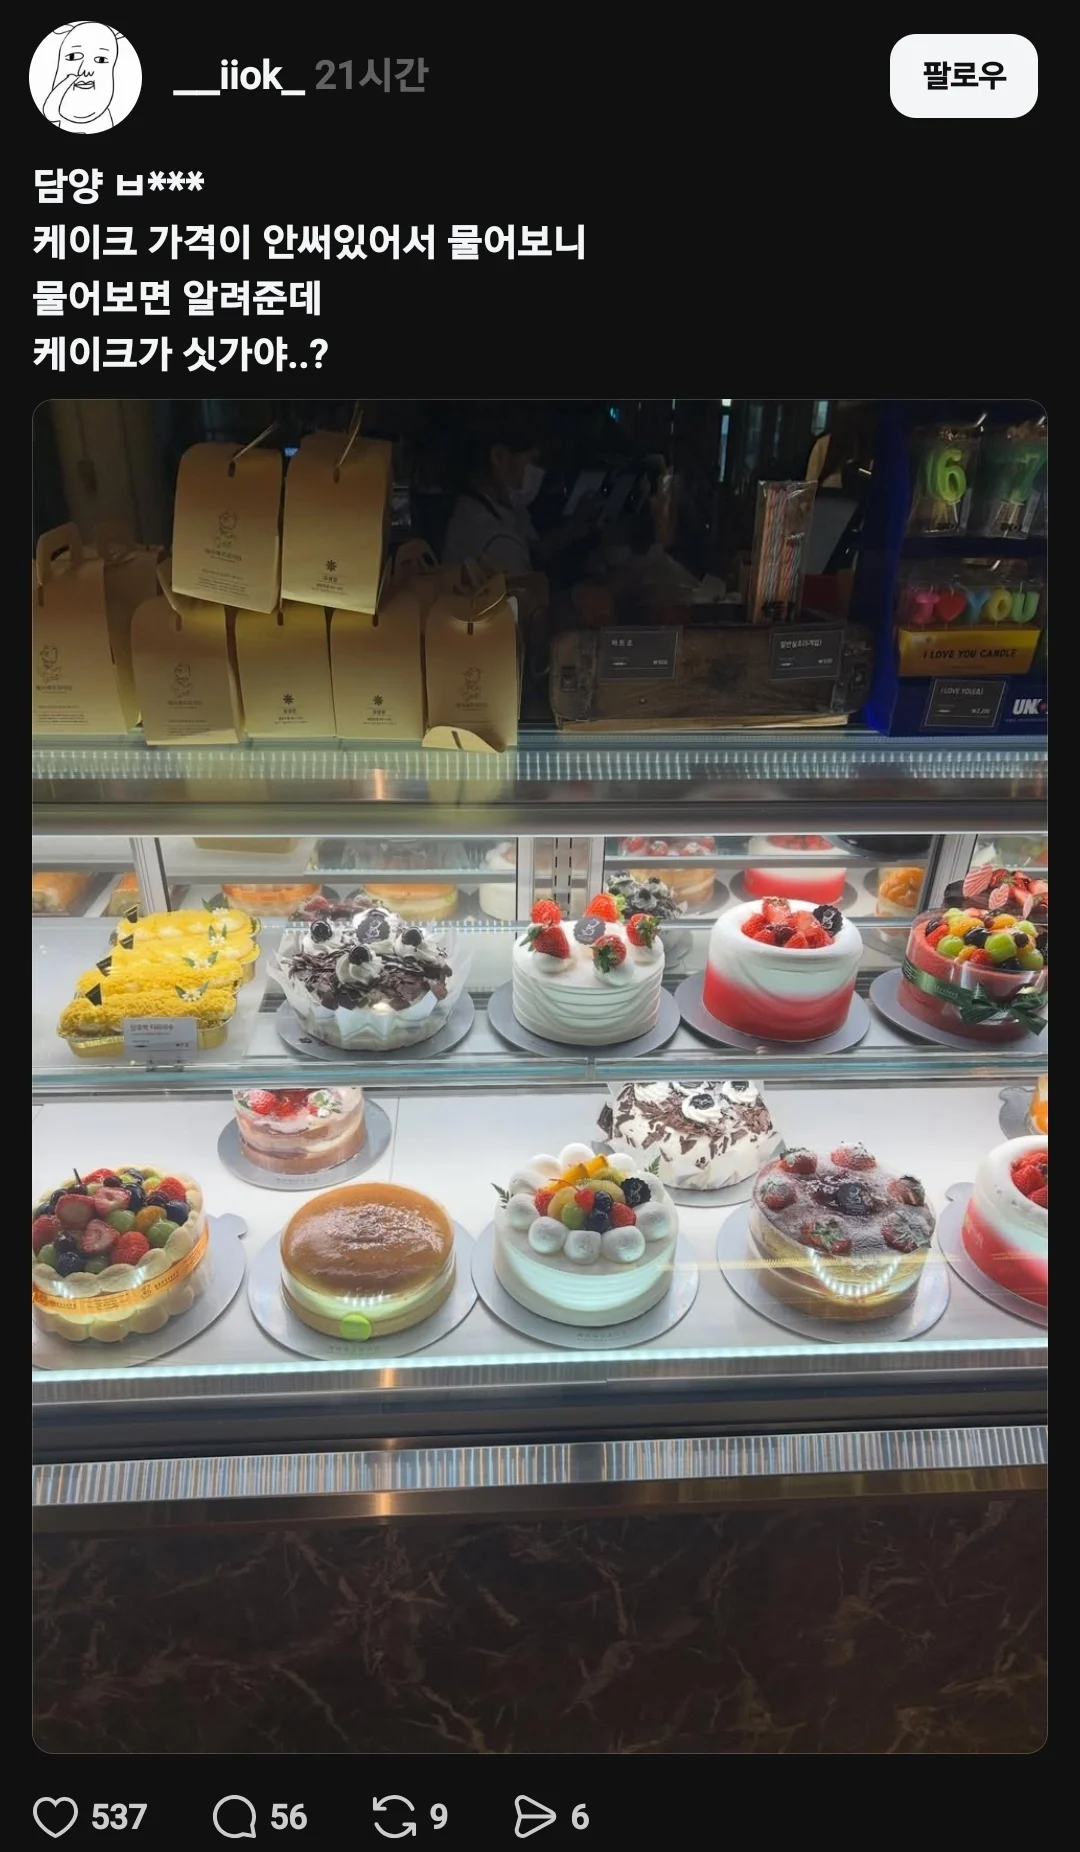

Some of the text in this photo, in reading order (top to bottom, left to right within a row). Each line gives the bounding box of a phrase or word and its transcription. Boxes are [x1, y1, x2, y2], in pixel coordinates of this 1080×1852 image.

[936, 449, 967, 503] 6
[929, 650, 954, 659] LOVE
[958, 650, 978, 658] YOU
[980, 649, 1018, 659] CANDLE
